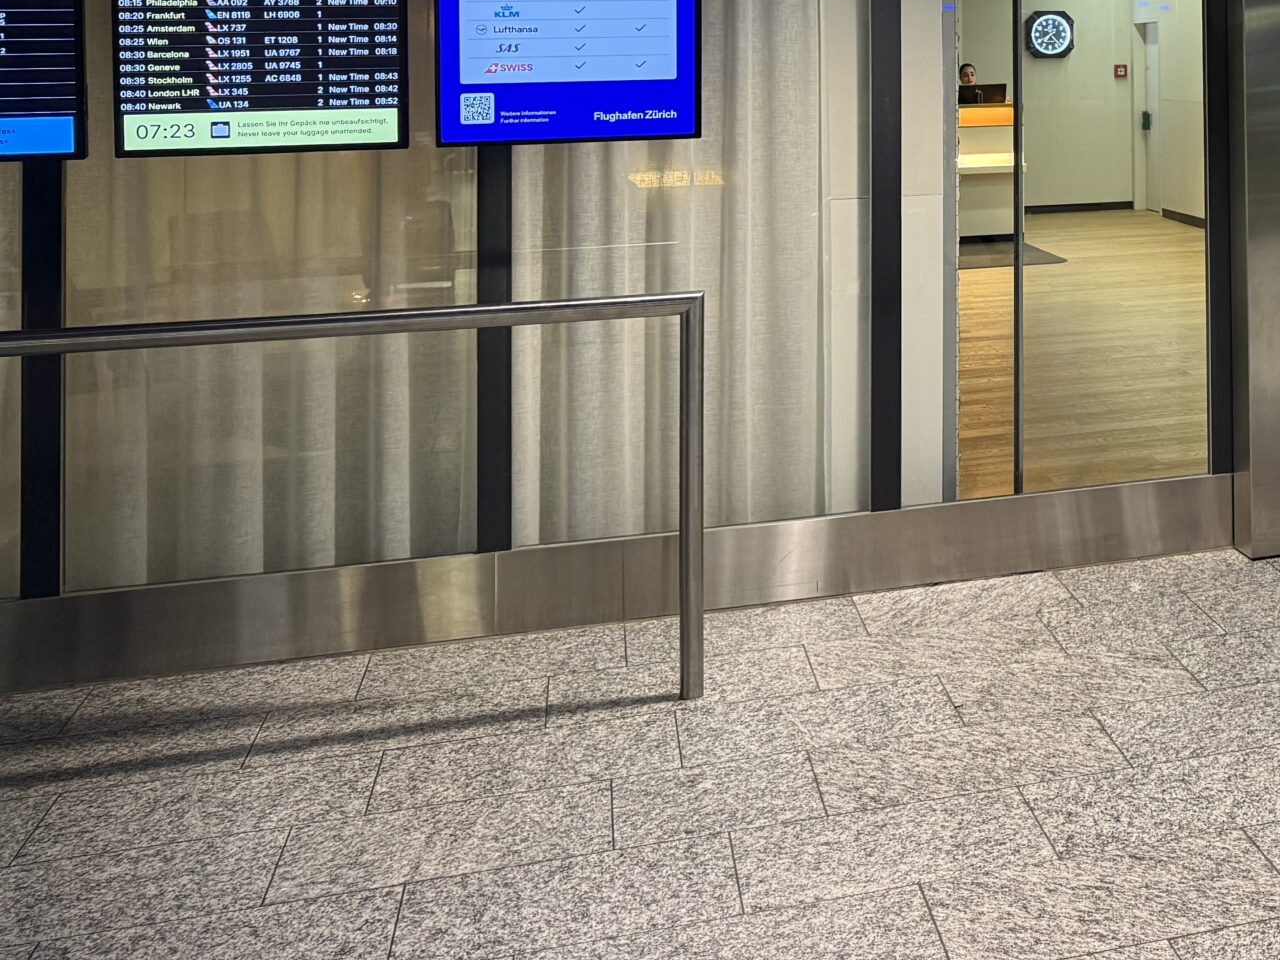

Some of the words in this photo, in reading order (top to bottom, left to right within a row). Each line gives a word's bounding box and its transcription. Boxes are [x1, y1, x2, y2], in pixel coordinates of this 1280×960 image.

[119, 12, 144, 20] 08:20
[146, 11, 185, 20] Frankfurt
[119, 25, 144, 33] 08:25
[146, 24, 195, 32] Amsterdam
[494, 25, 538, 33] Lufthansa
[119, 38, 145, 46] 08:25
[147, 37, 168, 45] Wien
[496, 44, 520, 52] SAS
[120, 51, 145, 59] 08:30
[147, 50, 189, 58] Barcelona
[120, 64, 146, 72] 08:30
[148, 63, 180, 72] Geneve
[120, 77, 146, 85] 08:35
[148, 76, 193, 84] Stockholm
[120, 90, 146, 98] 08:40
[148, 89, 179, 97] London
[121, 103, 146, 111] 08:40
[148, 102, 181, 110] Newark
[594, 111, 644, 122] Flughafen
[645, 109, 677, 119] Zürich
[136, 123, 195, 140] 07:23
